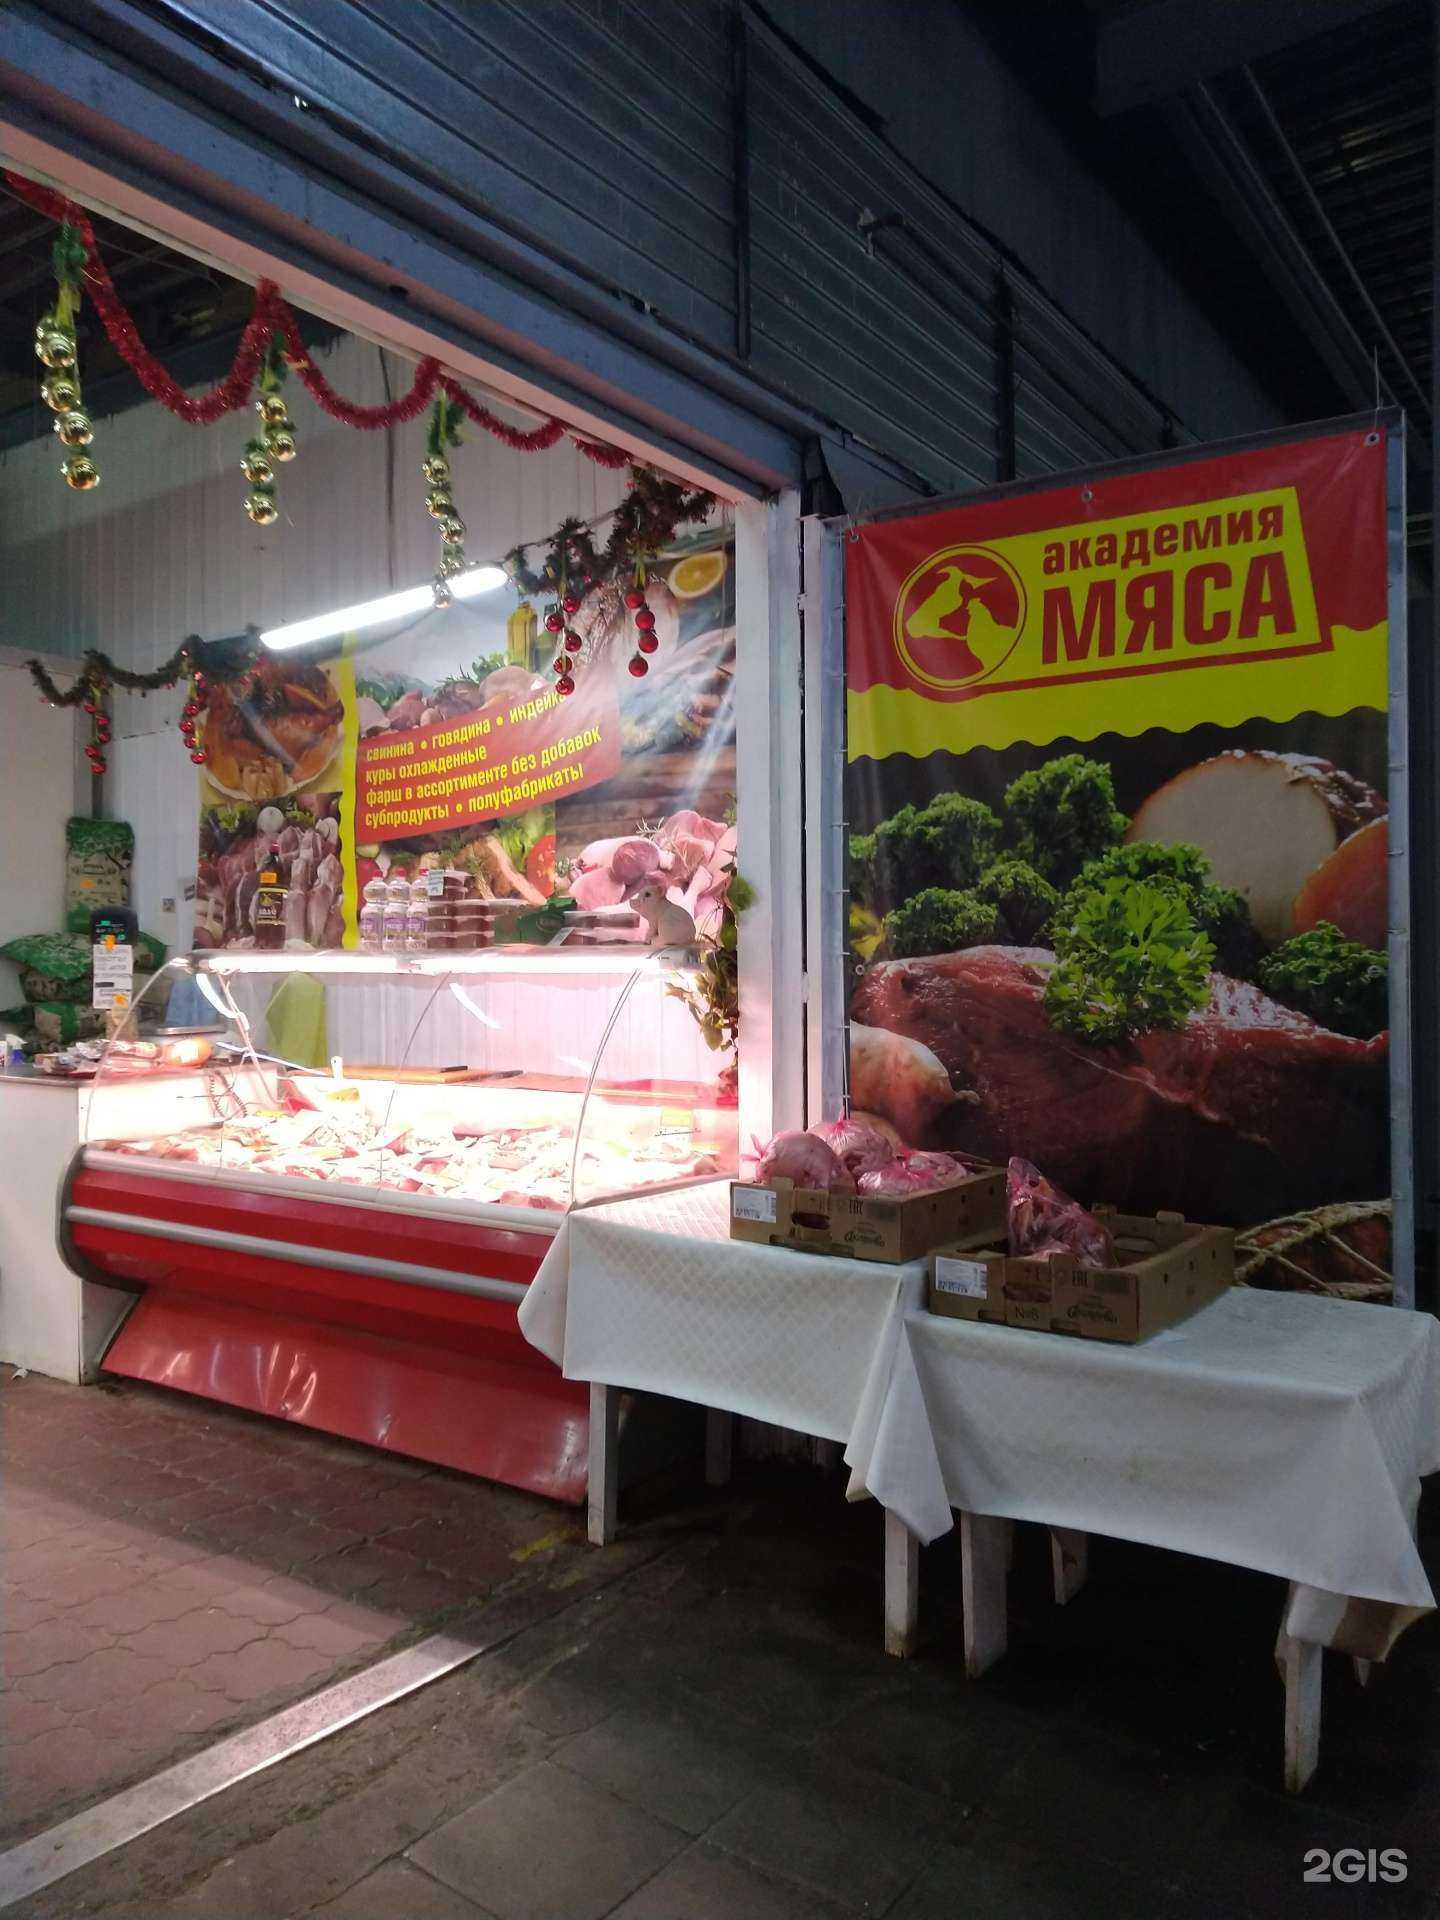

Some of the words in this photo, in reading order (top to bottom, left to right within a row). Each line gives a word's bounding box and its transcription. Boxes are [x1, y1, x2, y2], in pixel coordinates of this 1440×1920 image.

[1042, 503, 1284, 575] академия
[1041, 550, 1297, 665] МЯСА
[366, 740, 415, 762] свинина
[432, 718, 491, 749] говядина
[366, 768, 396, 785] куры
[399, 744, 488, 780] охлажденные
[366, 786, 402, 807] фарш
[404, 787, 413, 800] в
[416, 762, 508, 799] ассортименте
[511, 754, 537, 775] без
[541, 725, 602, 767] добавок
[365, 802, 449, 829] субпродукты
[467, 762, 584, 813] полуфабрикаты
